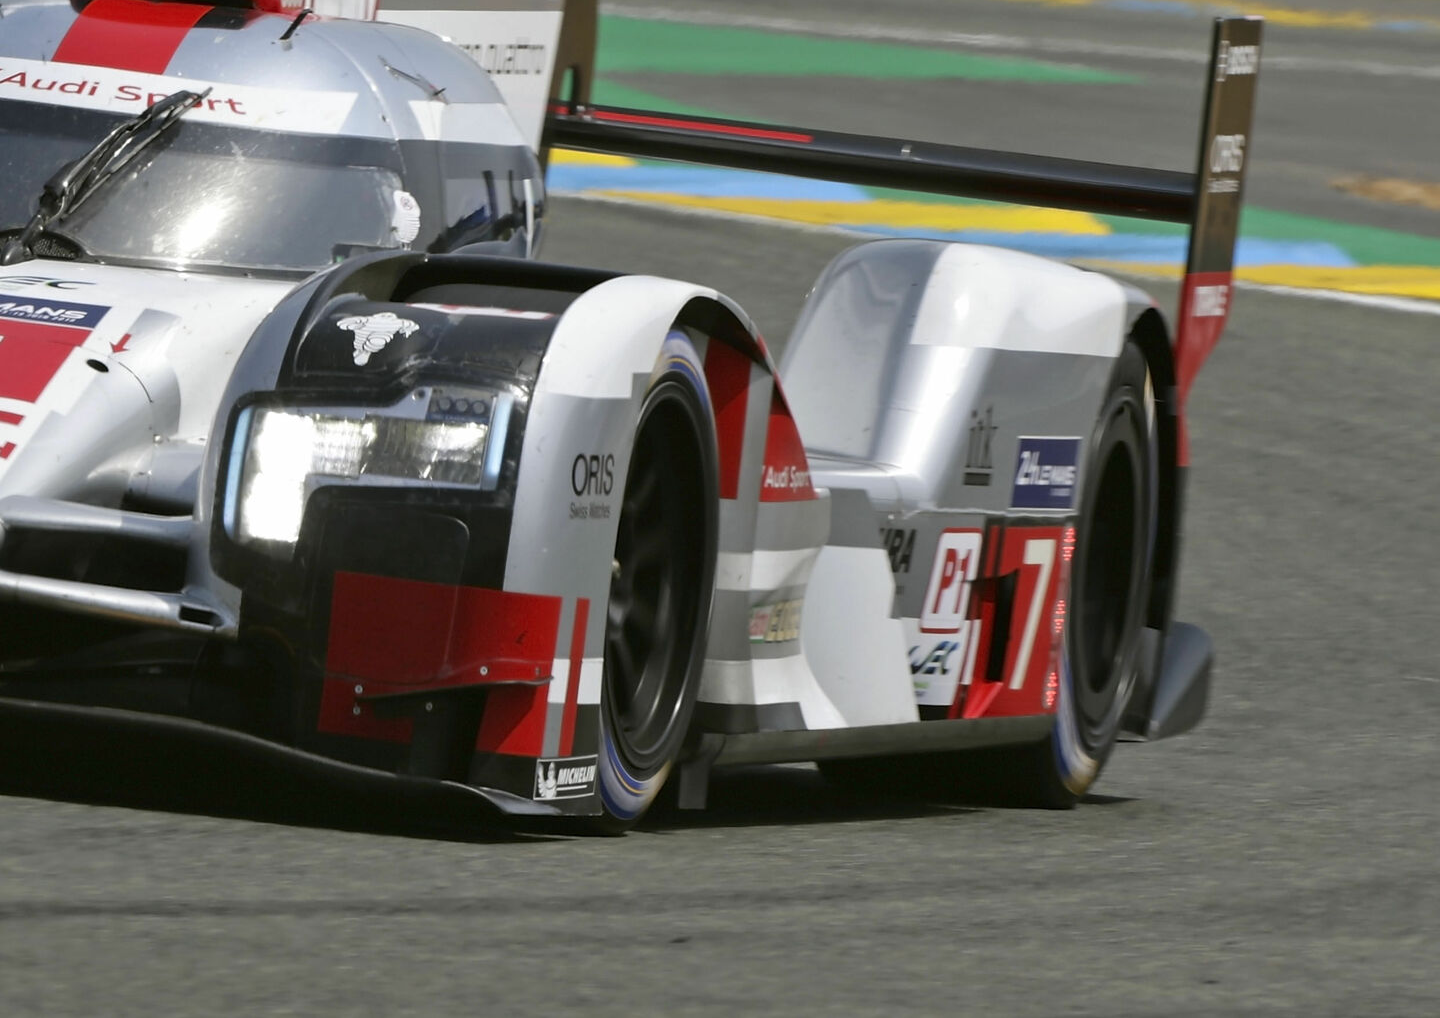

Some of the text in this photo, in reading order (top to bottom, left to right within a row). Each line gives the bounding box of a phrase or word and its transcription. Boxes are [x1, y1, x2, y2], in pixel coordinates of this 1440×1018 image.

[114, 85, 247, 115] Sprt
[571, 453, 616, 497] ORIS
[930, 548, 973, 614] P1
[1007, 538, 1057, 690] 7
[556, 764, 598, 785] MICHELIN
